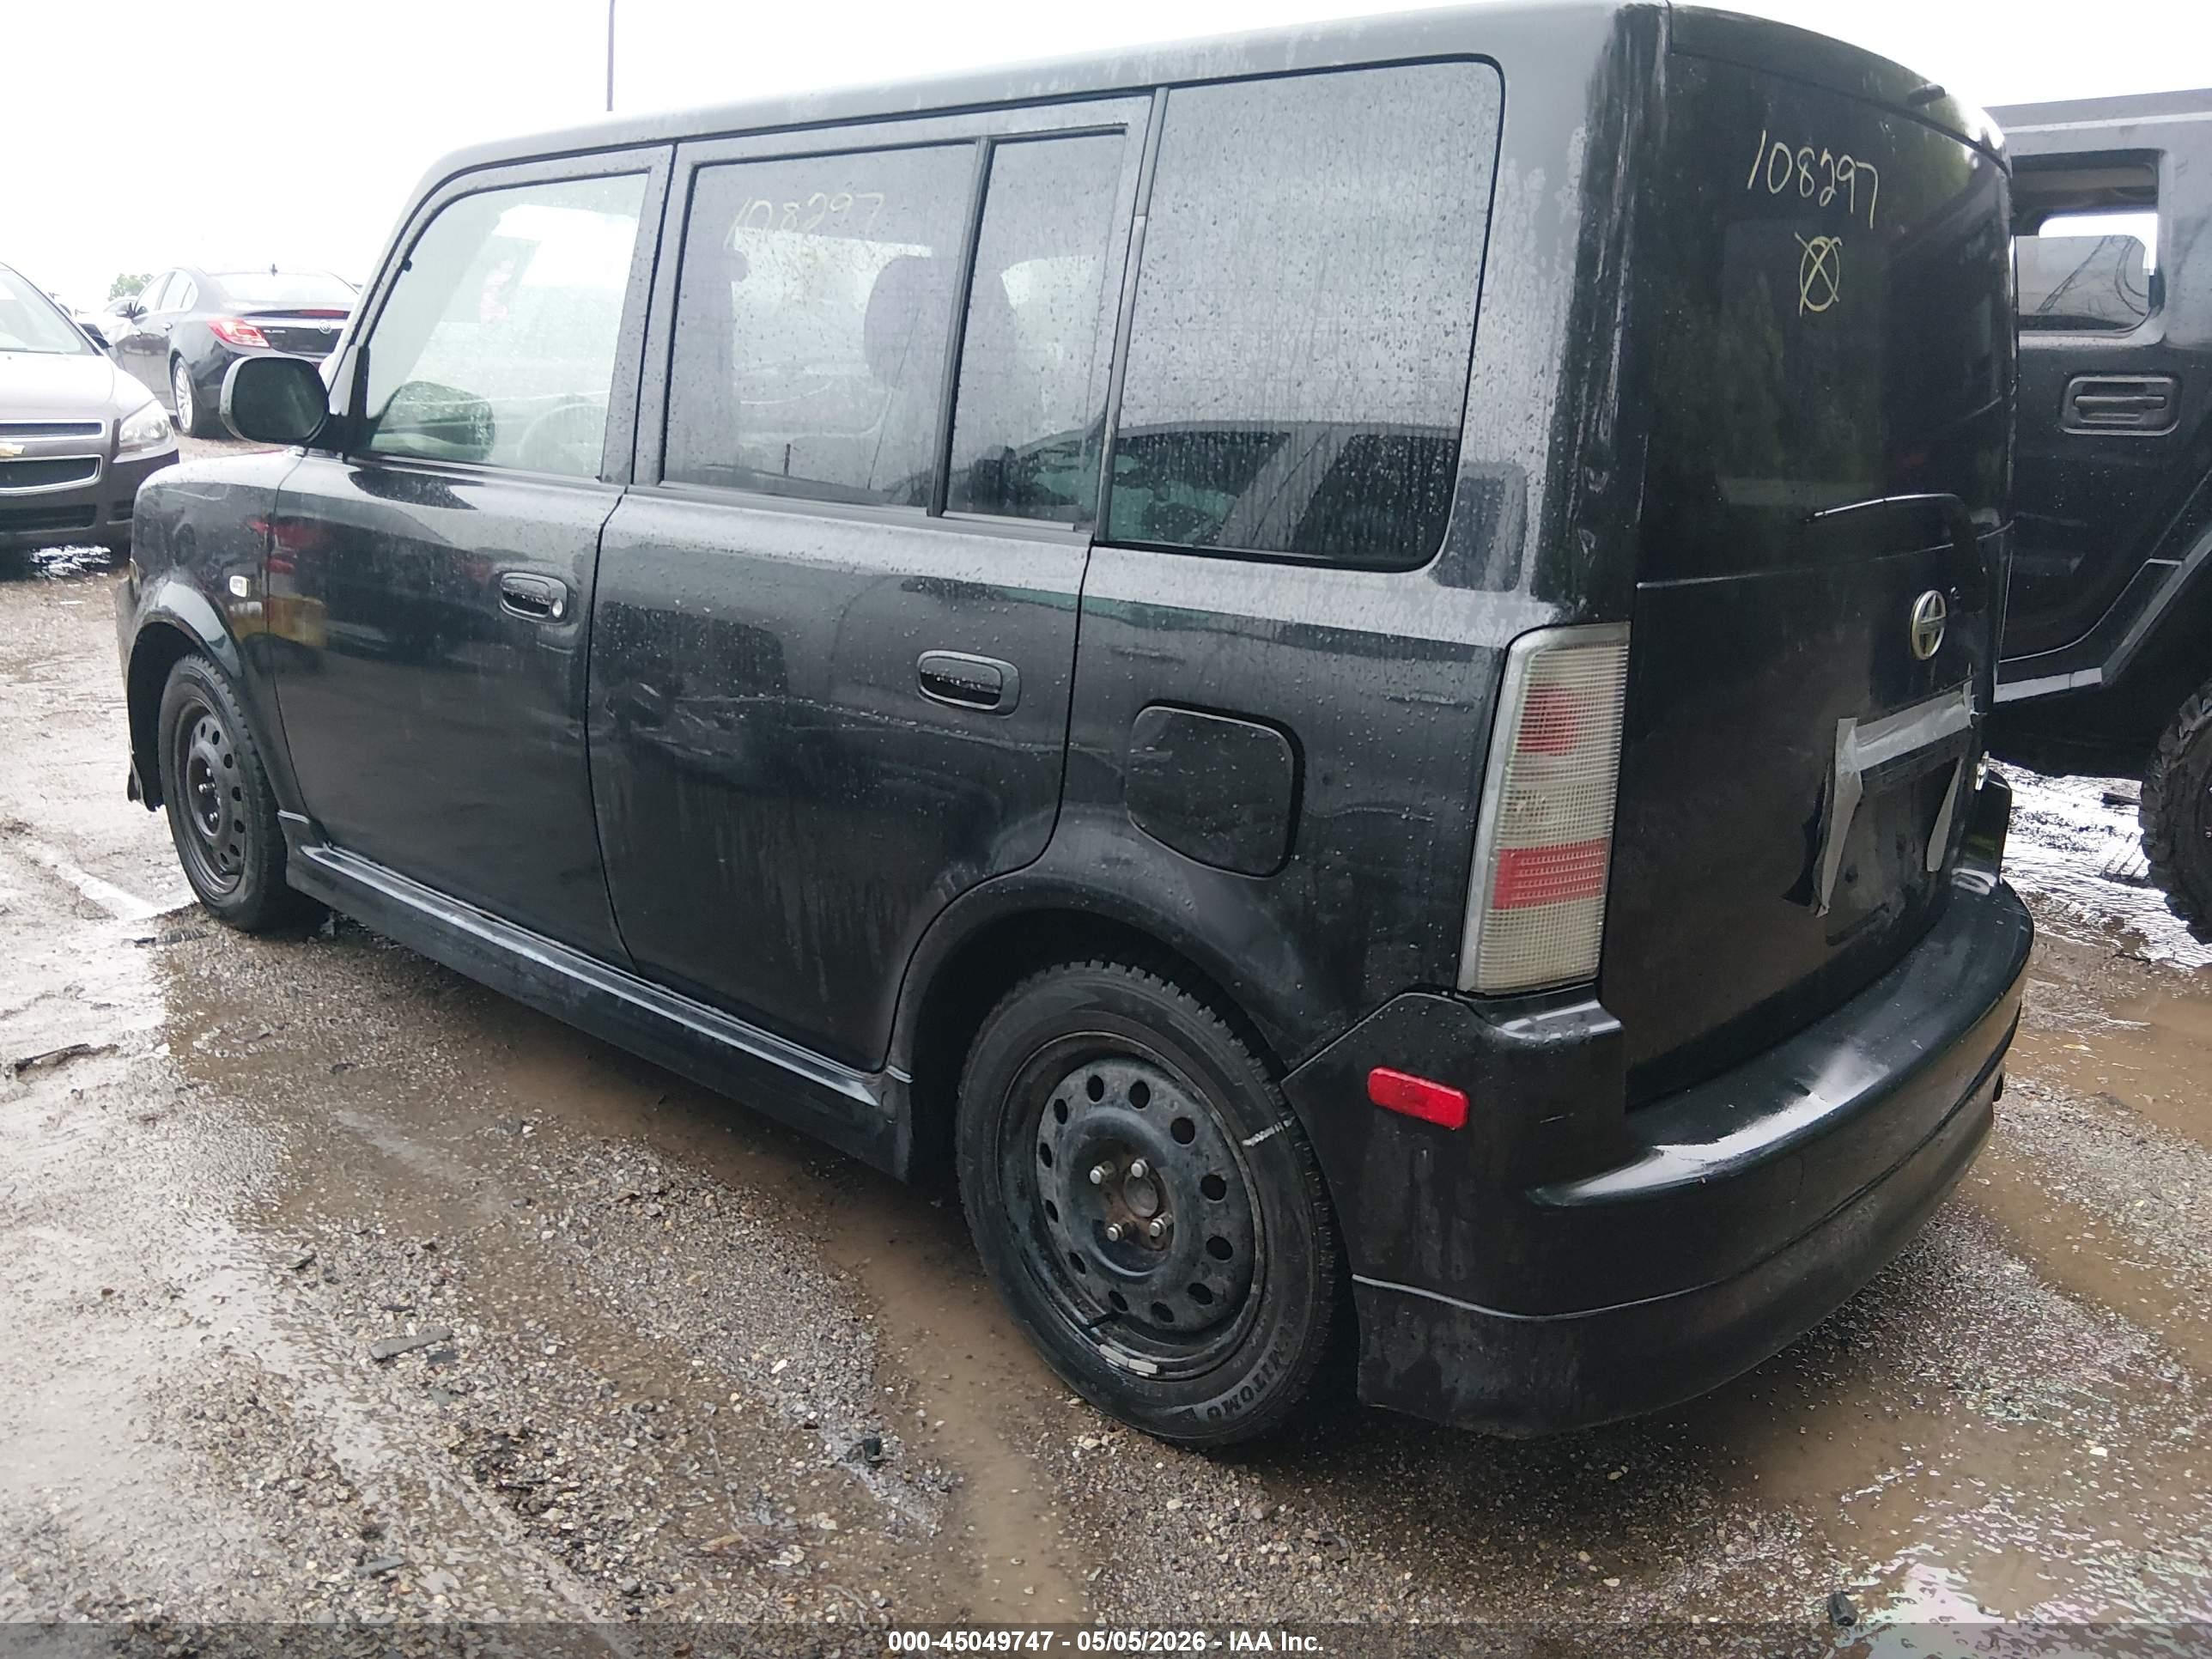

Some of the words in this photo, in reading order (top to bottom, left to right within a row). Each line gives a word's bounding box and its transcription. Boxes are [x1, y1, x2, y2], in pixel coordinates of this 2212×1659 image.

[722, 191, 885, 252] 108297
[1747, 129, 1880, 230] 108297
[1206, 1304, 1297, 1420] MITOMO
